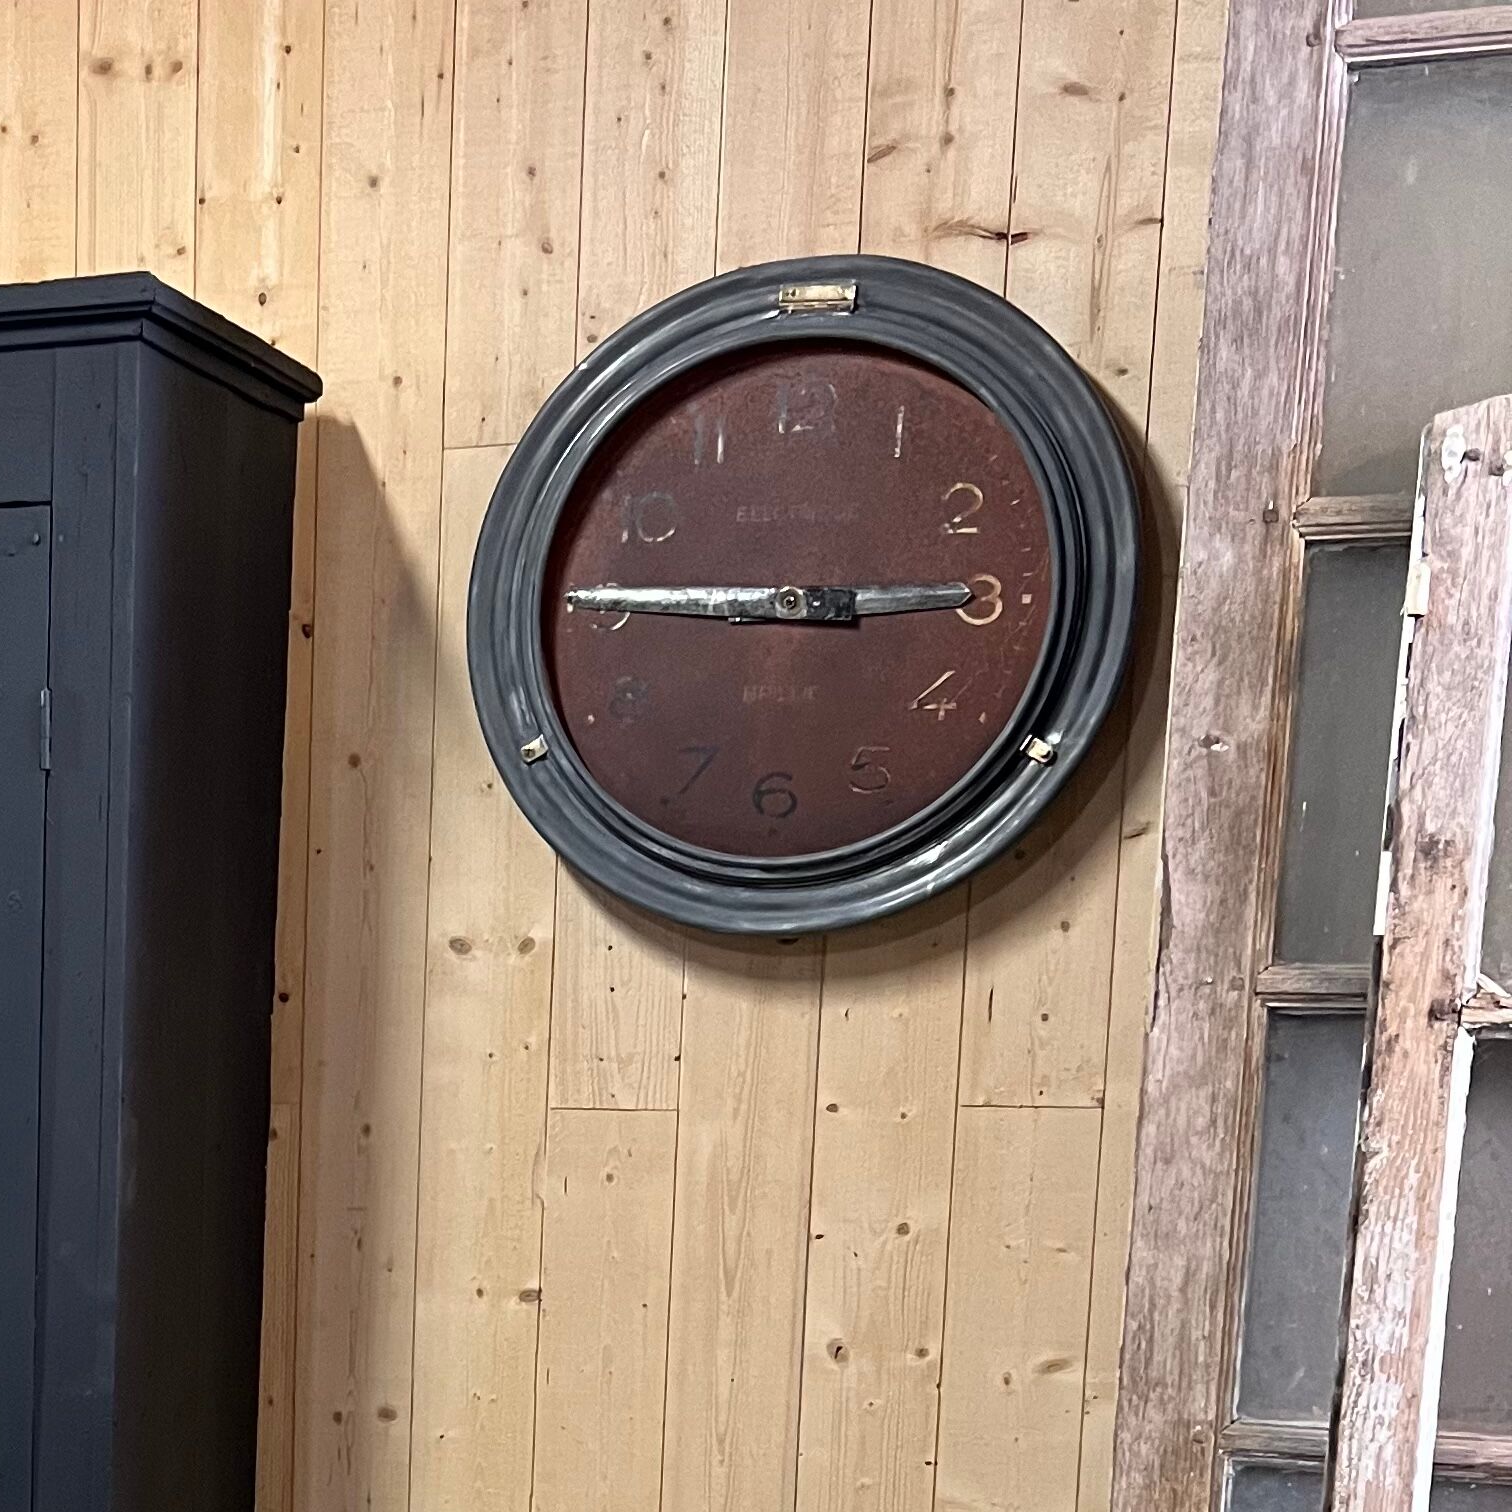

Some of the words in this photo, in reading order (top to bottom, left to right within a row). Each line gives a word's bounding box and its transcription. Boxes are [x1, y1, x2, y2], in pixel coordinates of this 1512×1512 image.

[942, 483, 984, 535] 2
[956, 574, 1004, 627] 3
[909, 670, 958, 722] 4
[679, 746, 721, 795] 7
[752, 771, 798, 819] 6
[848, 746, 891, 794] 5
